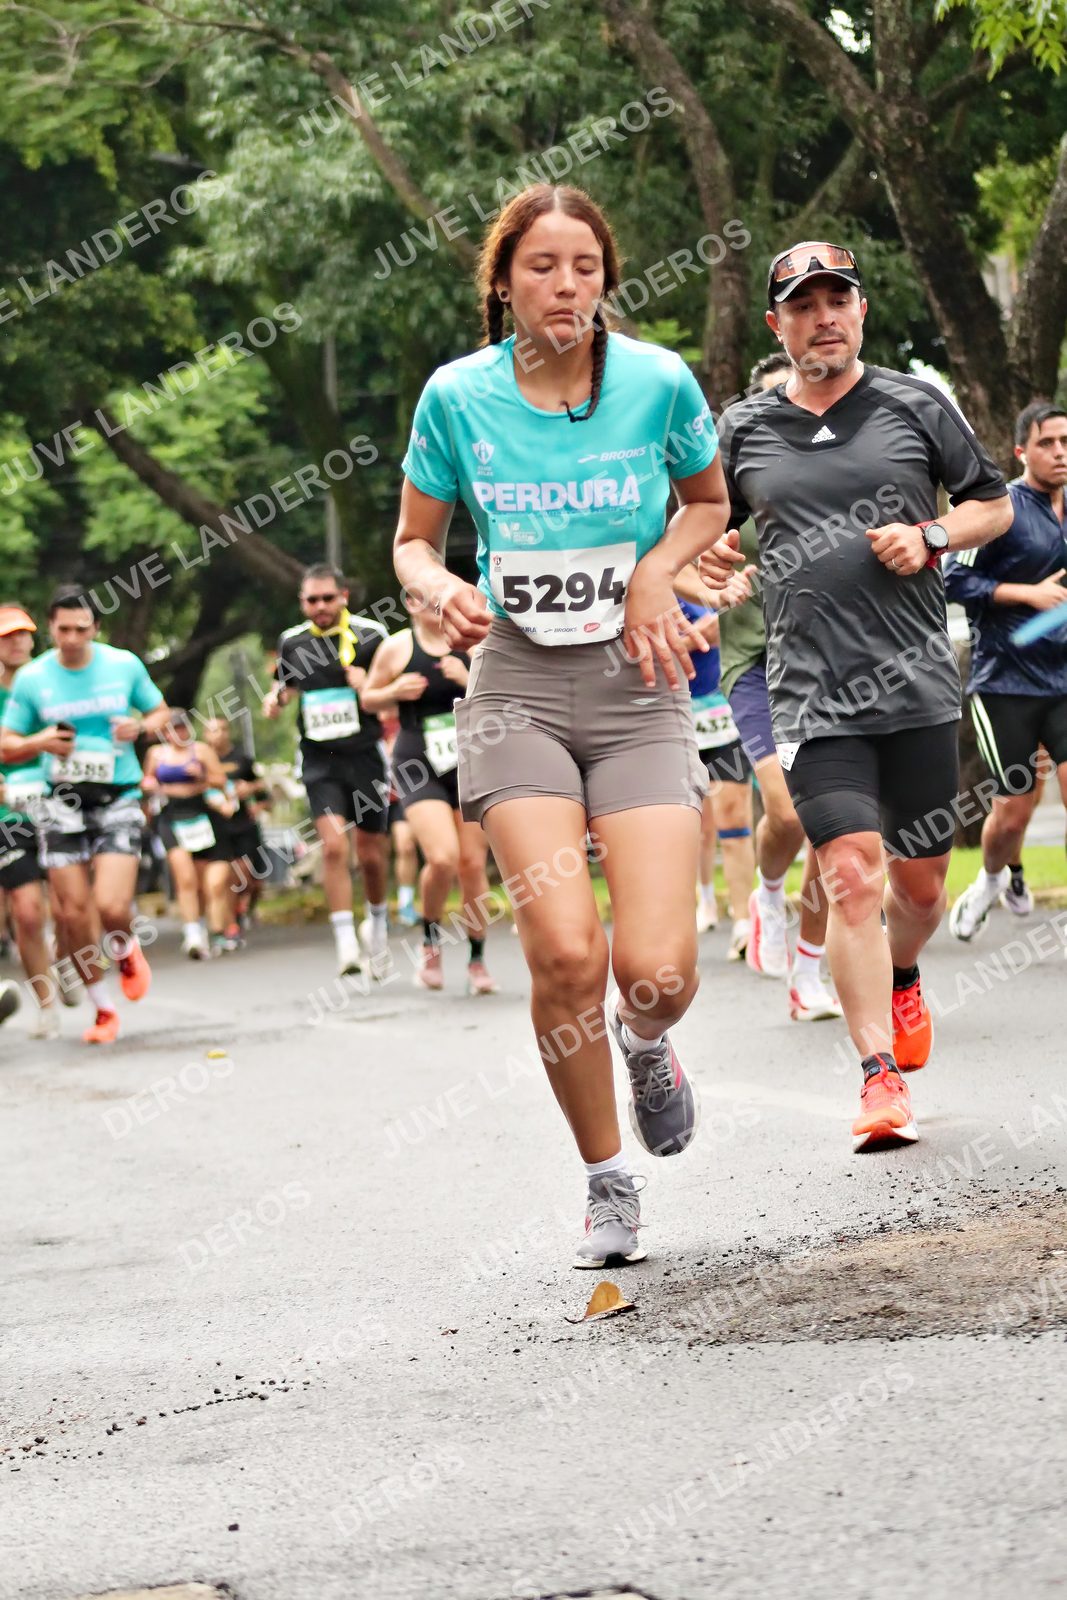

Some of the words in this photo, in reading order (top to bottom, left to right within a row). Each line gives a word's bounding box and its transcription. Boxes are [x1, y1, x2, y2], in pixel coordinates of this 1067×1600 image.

[599, 446, 647, 462] BROOKS
[472, 475, 642, 512] PERDURA
[502, 567, 626, 614] 5294
